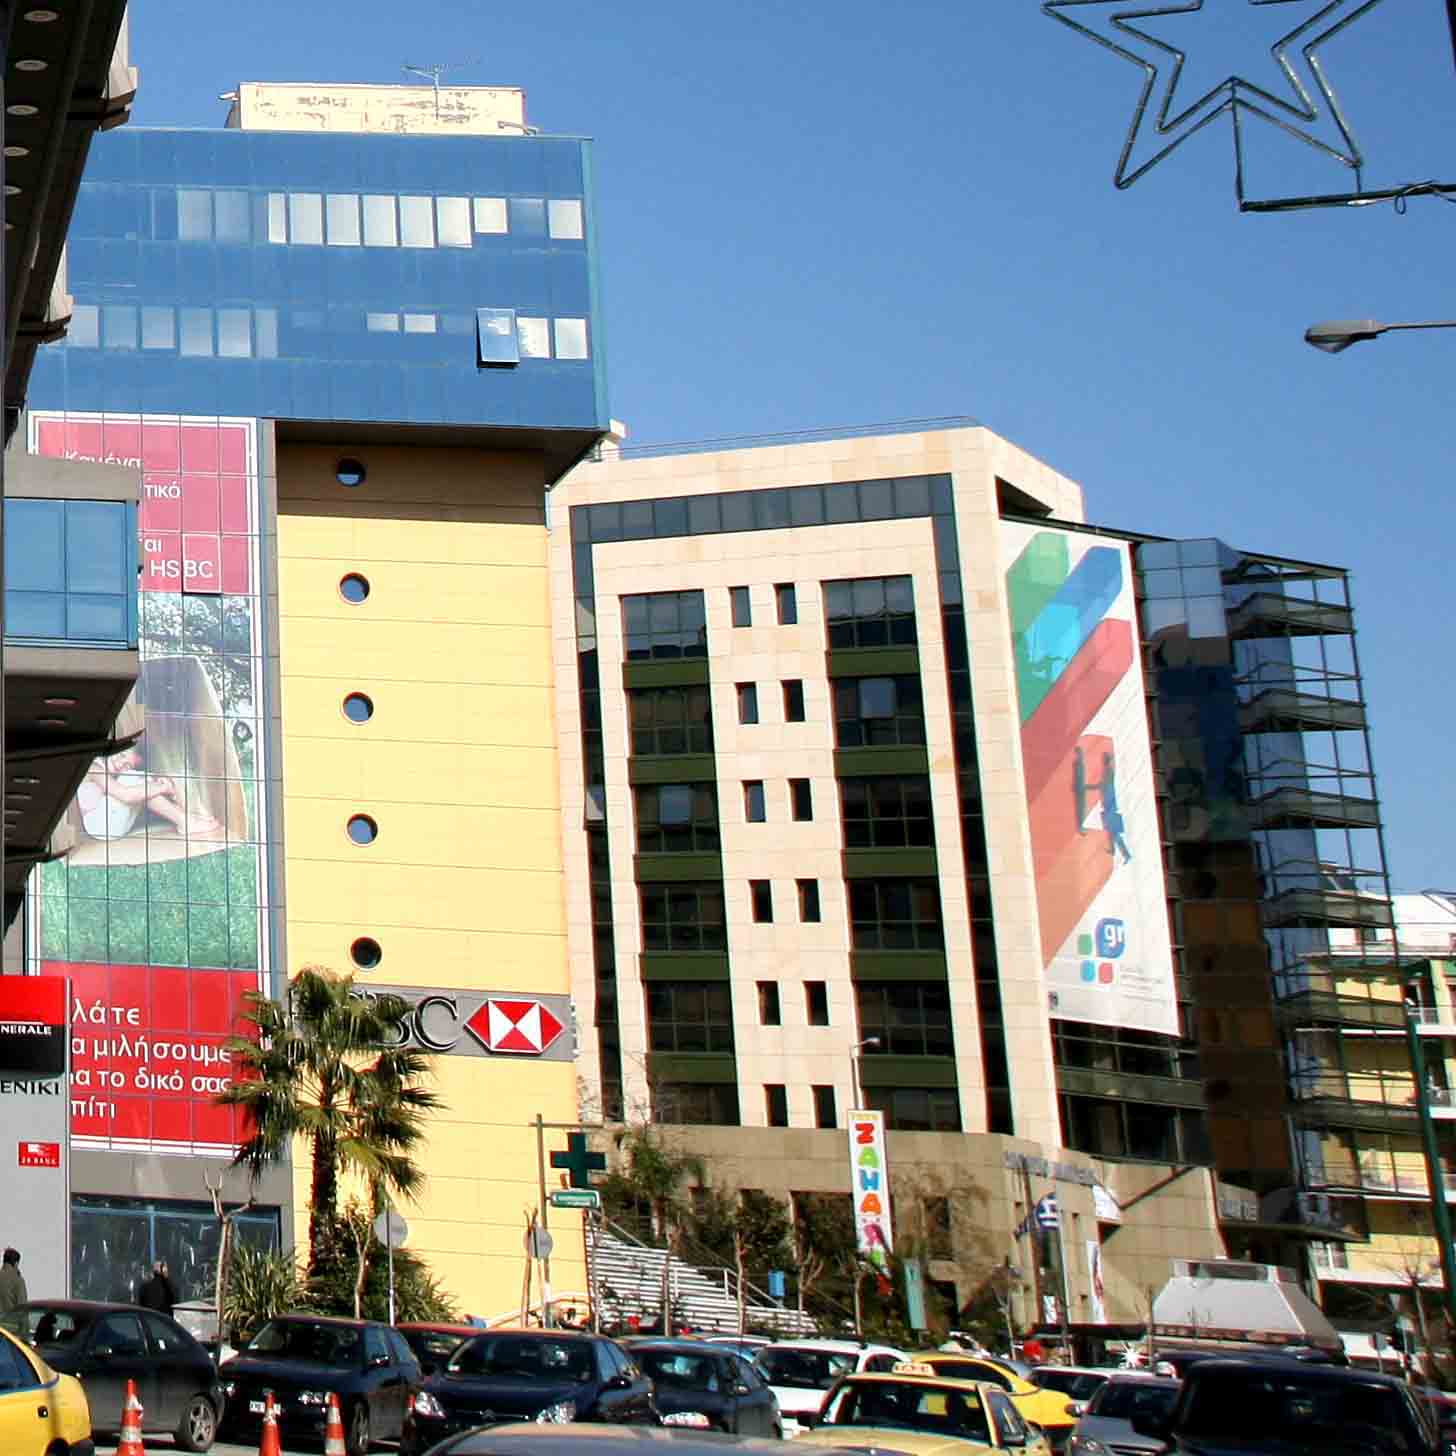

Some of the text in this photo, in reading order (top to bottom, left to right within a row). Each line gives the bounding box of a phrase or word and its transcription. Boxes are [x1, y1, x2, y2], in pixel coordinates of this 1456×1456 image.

[150, 559, 214, 578] HSBC
[93, 1034, 233, 1067] μιλήσουμε
[96, 1071, 125, 1088] το
[134, 1067, 184, 1091] δικό
